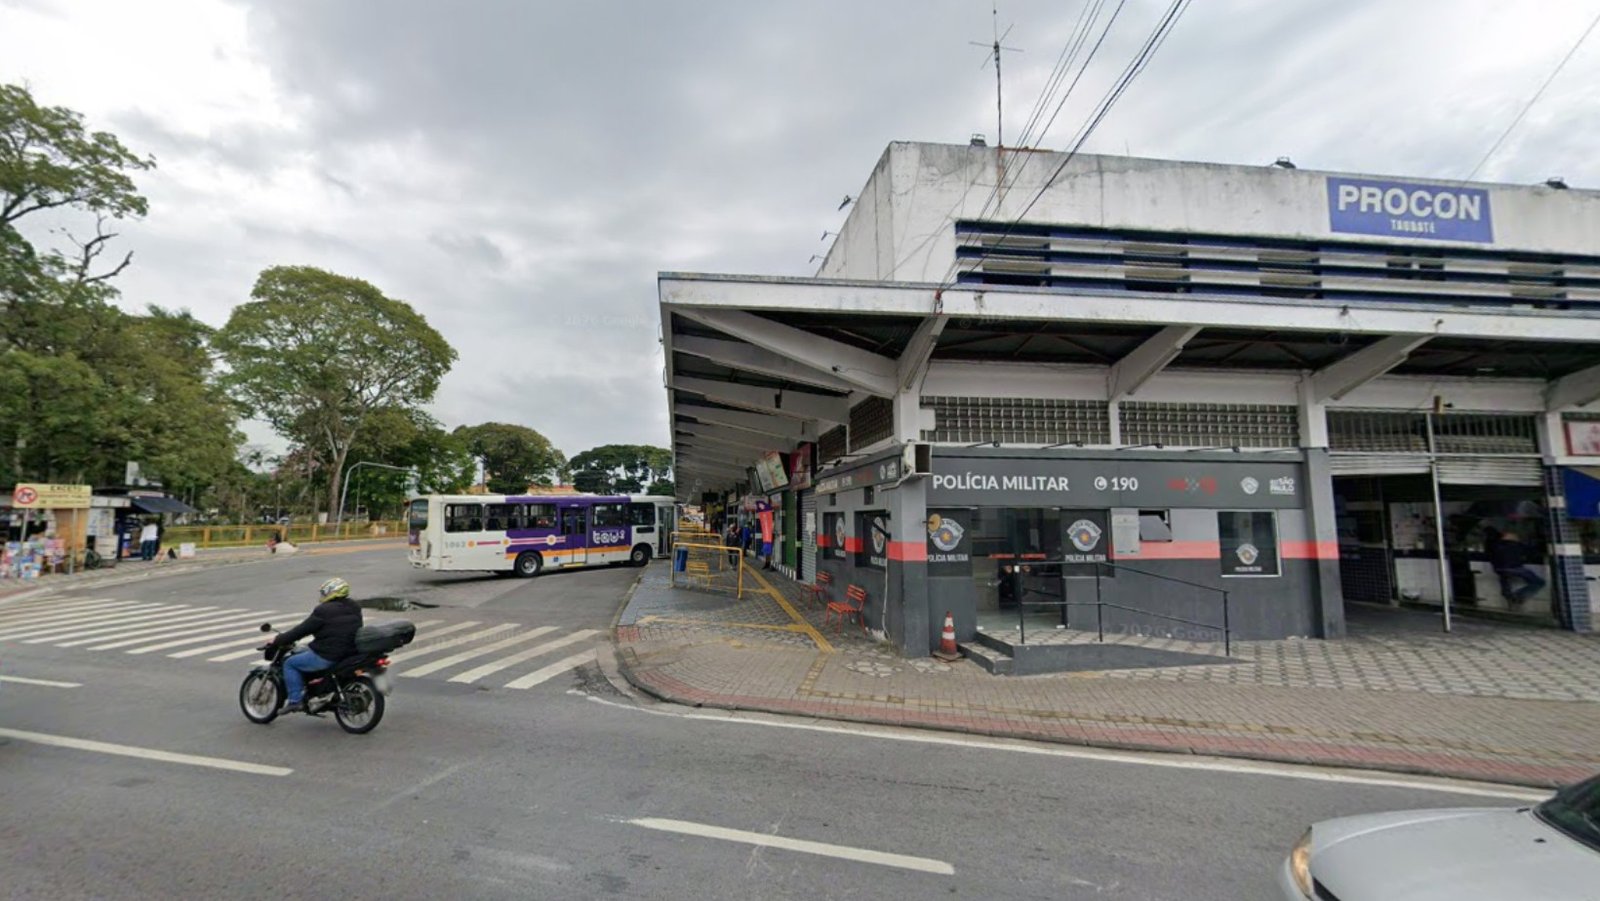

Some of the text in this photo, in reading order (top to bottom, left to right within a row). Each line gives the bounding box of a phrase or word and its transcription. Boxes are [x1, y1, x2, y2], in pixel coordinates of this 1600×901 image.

[1338, 184, 1480, 220] PROCON
[932, 471, 1139, 491] POLÍCIA MILITAR 190
